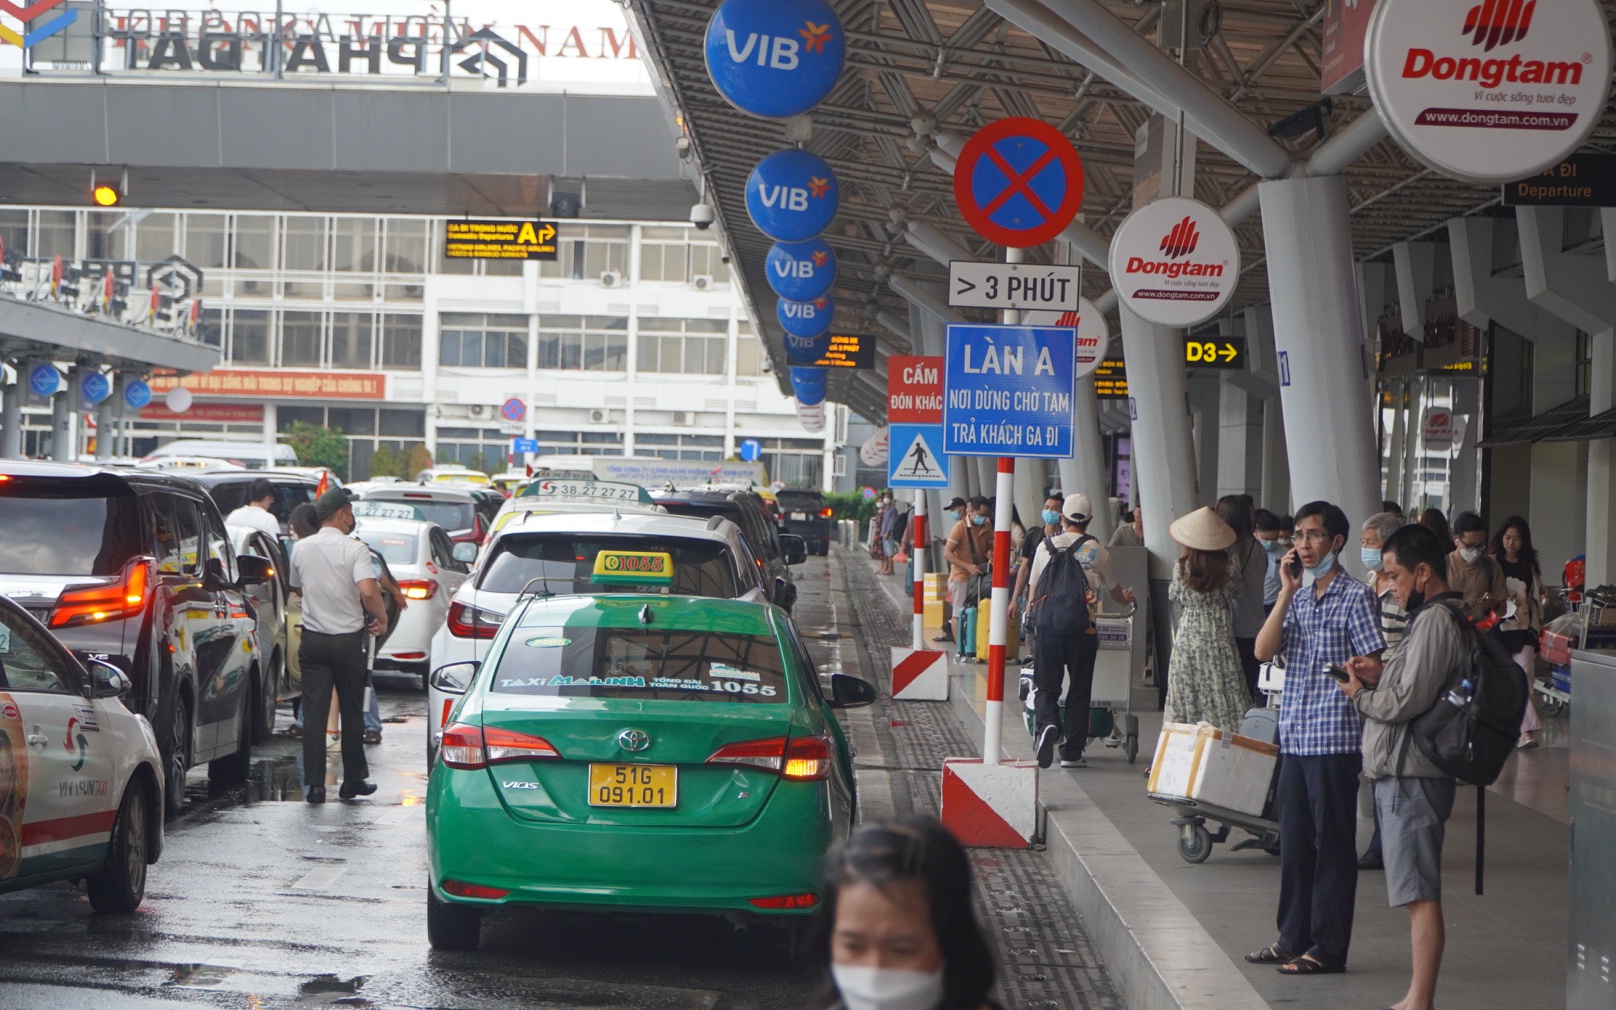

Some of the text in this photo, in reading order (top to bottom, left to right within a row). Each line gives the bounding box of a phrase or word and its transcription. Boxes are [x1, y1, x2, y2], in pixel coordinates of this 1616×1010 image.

[513, 24, 636, 60] NAM
[726, 28, 799, 71] VIB
[1401, 47, 1583, 89] Dongtam
[1485, 91, 1507, 103] cuộc
[1509, 90, 1533, 105] sống
[1557, 94, 1577, 106] đẹp
[1425, 111, 1569, 128] www.dongtam.com.vn
[1559, 163, 1577, 177] ĐI
[758, 183, 809, 211] VIB
[1518, 183, 1592, 200] Departure
[516, 222, 538, 244] A
[774, 260, 814, 278] VIB
[1125, 257, 1224, 279] Dongtam
[985, 275, 999, 300] 3
[1007, 272, 1070, 303] PHÚT
[1137, 290, 1215, 300] www.dongtam.com.vn
[783, 304, 815, 319] VIB
[963, 336, 1055, 376] LÀN A
[1186, 341, 1217, 363] D3
[903, 362, 938, 385] CẤM
[890, 392, 943, 410] ĐÓN KHÁC
[949, 385, 1069, 415] NƠI DỪNG CHỜ TẠM
[952, 417, 1058, 446] TRẢ KHÁCH GA ĐI
[561, 484, 635, 500] 38.27 27 27
[354, 506, 412, 519] 8.27 27 27
[619, 555, 663, 572] 1055
[652, 676, 702, 685] TỔNG ĐÀI
[679, 683, 709, 691] QUỐC
[709, 680, 777, 697] 1055
[615, 766, 652, 785] 51G
[502, 781, 540, 790] VIOS
[599, 786, 665, 805] 091.01
